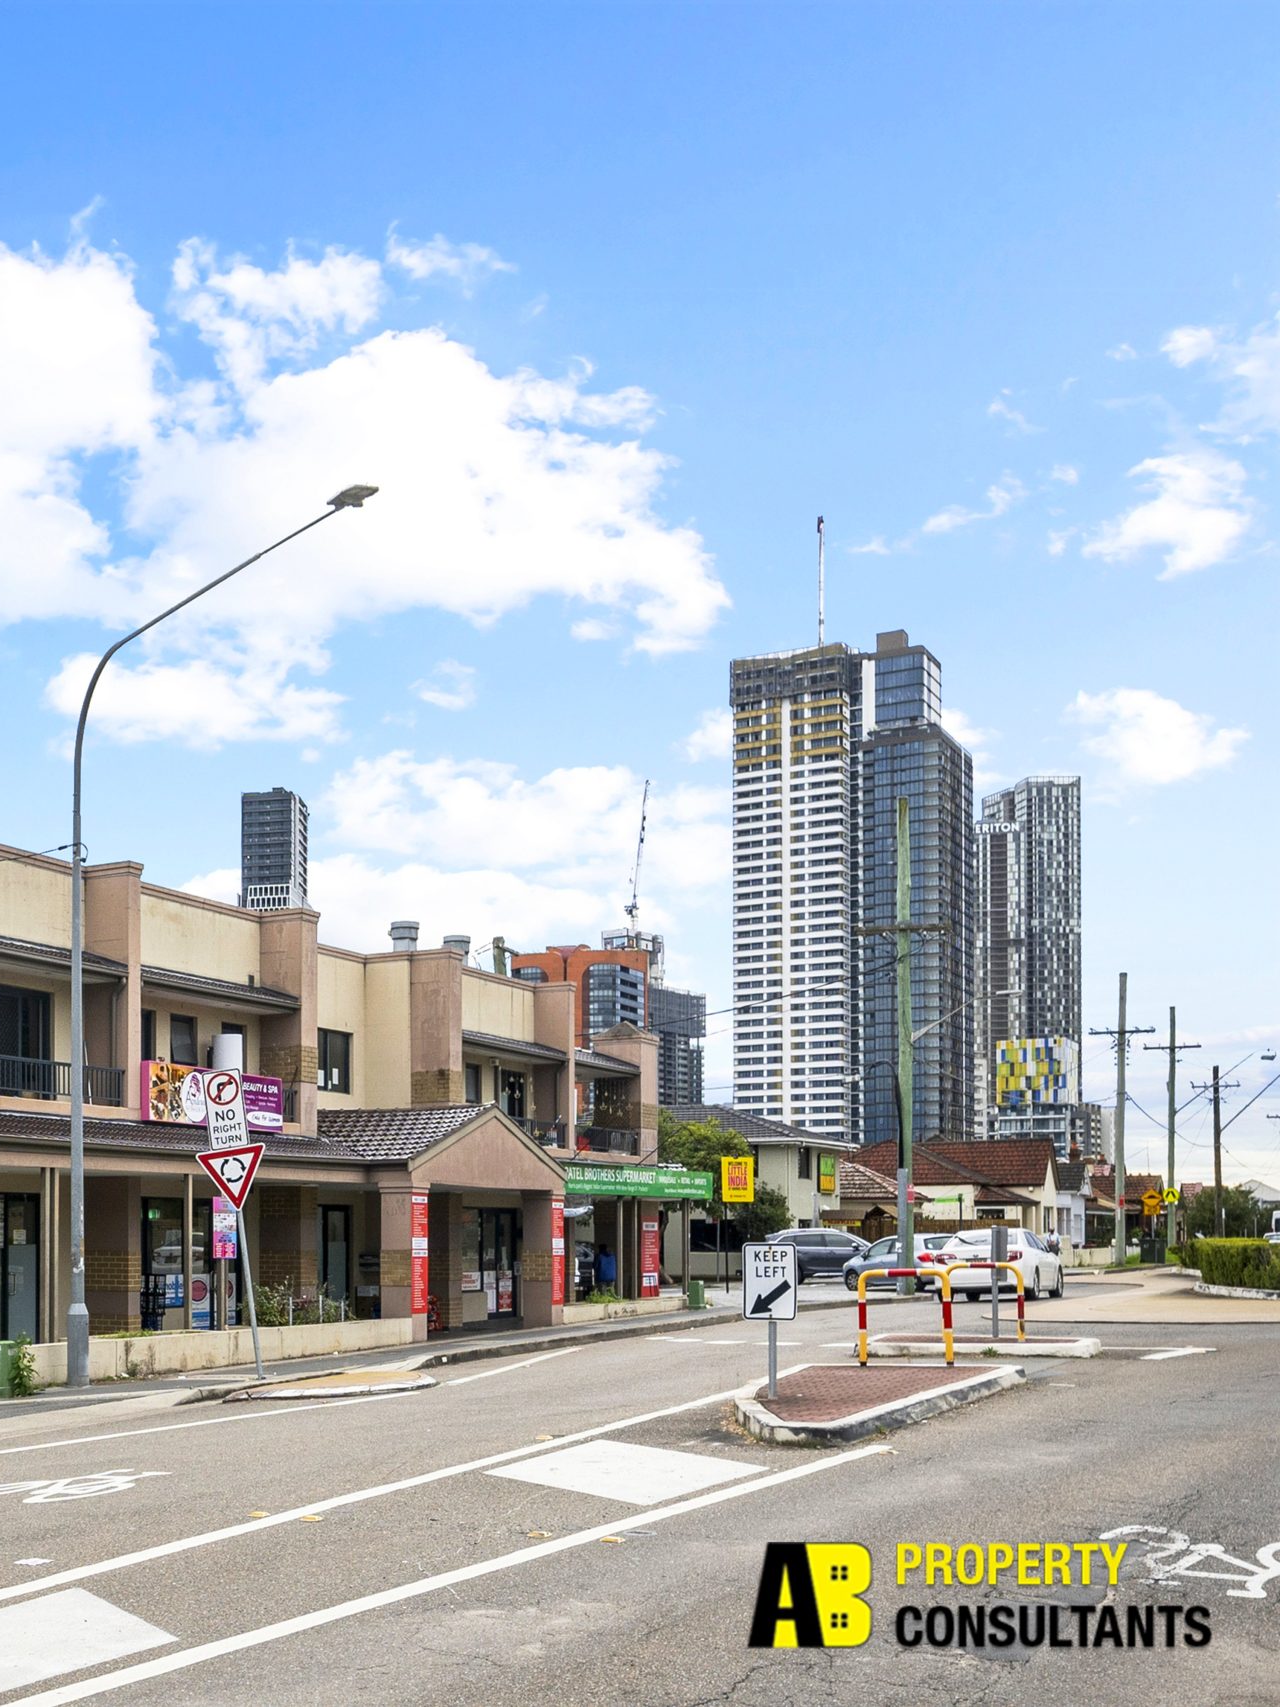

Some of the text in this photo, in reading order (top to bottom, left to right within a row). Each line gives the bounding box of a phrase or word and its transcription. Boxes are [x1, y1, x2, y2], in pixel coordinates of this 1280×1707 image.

[242, 1082, 278, 1094] BEAUTY & SPA
[215, 1109, 235, 1122] NO
[213, 1123, 242, 1134] RIGHT
[214, 1134, 242, 1145] TURN
[584, 1167, 615, 1181] BROTHERS
[615, 1169, 656, 1184] SUPERMARKET
[728, 1166, 748, 1175] LITTLE
[728, 1176, 748, 1186] INDIA
[754, 1250, 788, 1262] KEEP
[755, 1266, 786, 1278] LEFT
